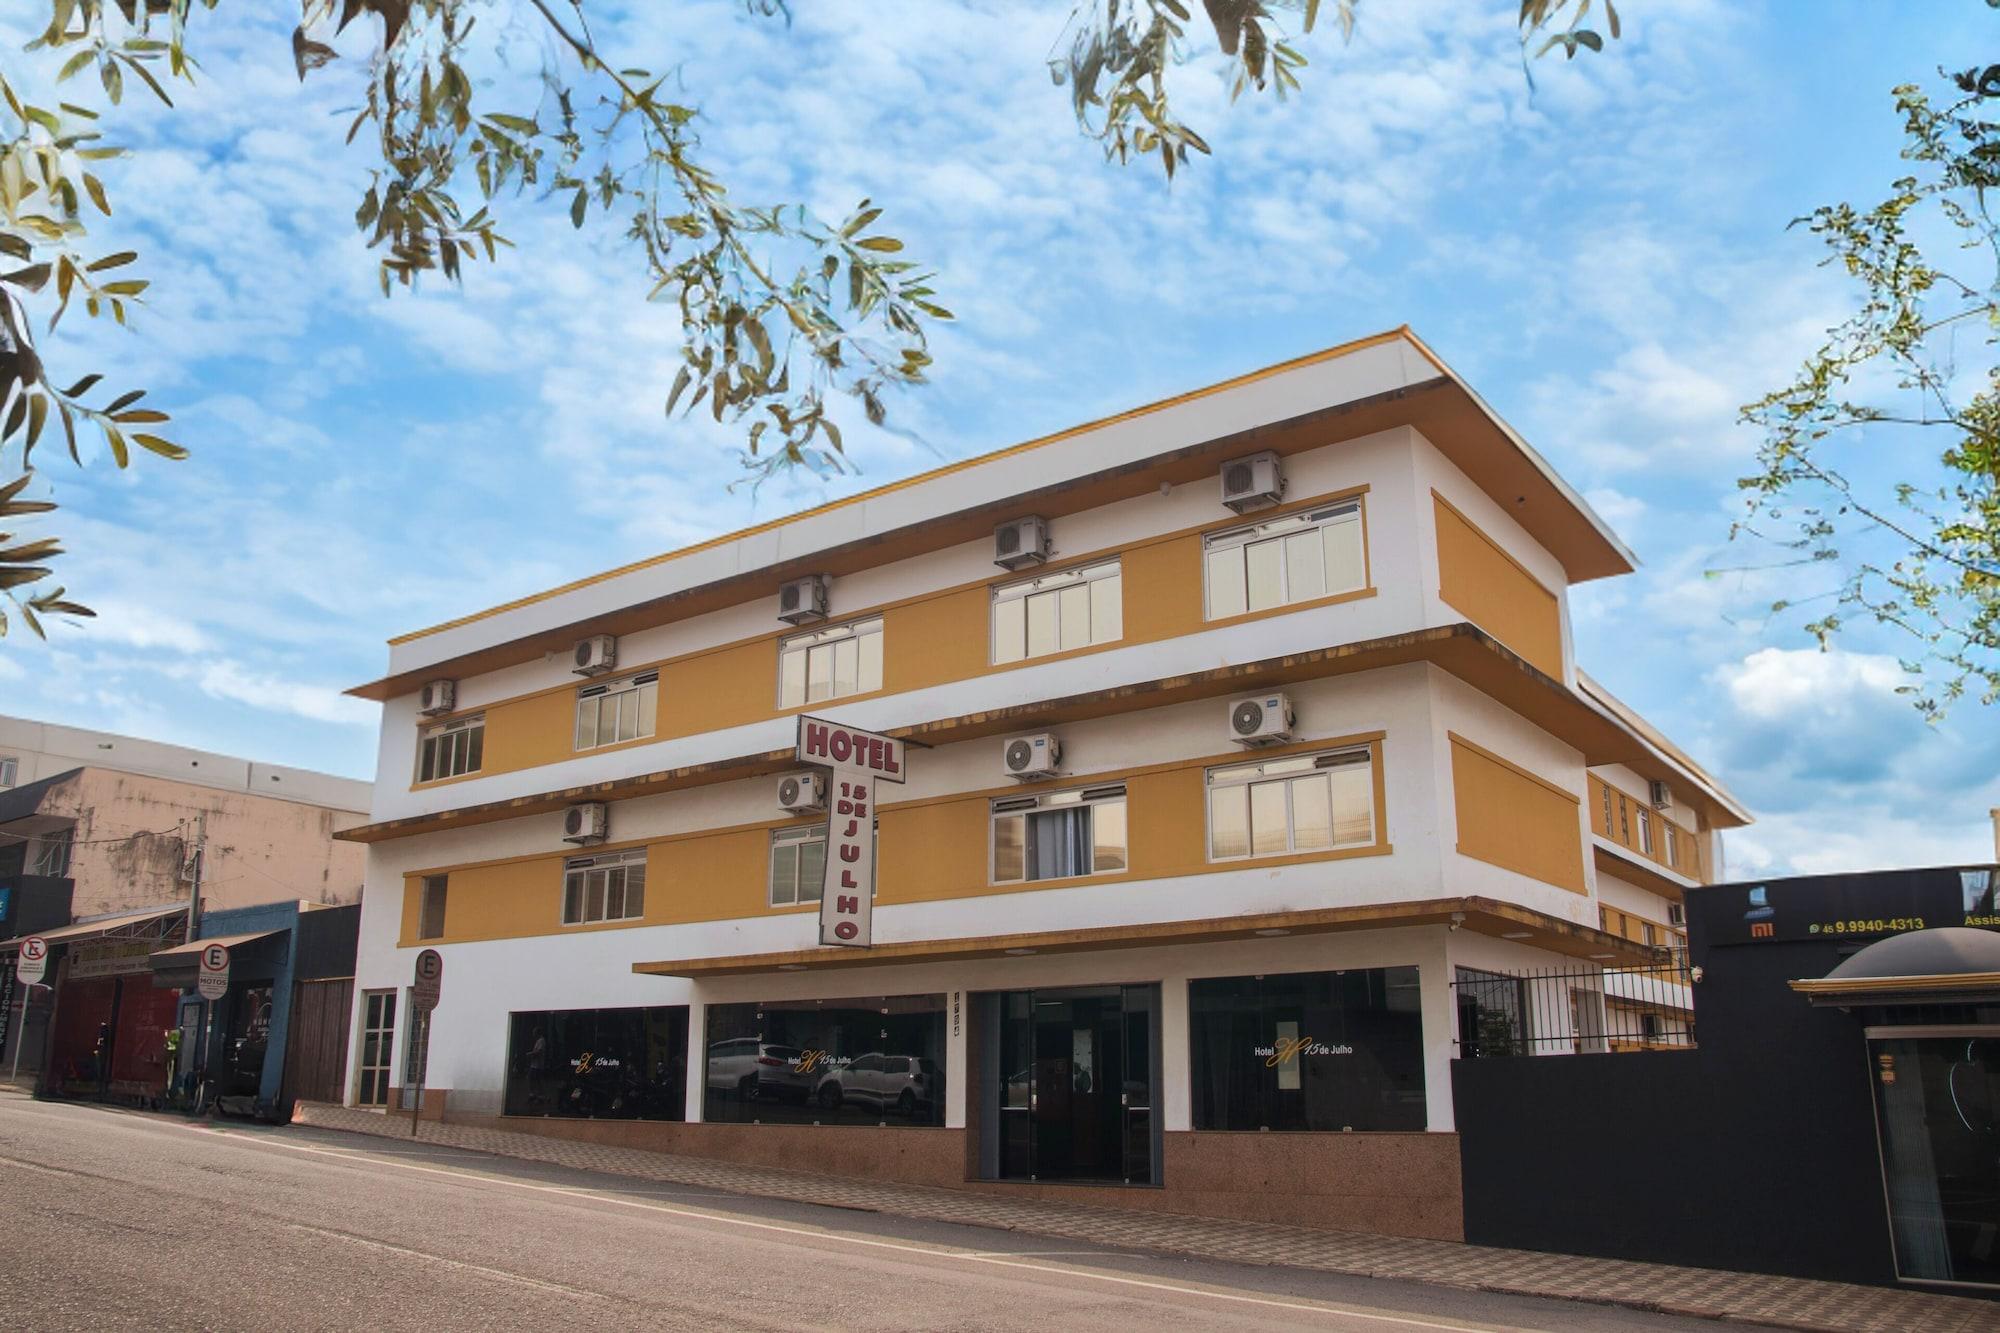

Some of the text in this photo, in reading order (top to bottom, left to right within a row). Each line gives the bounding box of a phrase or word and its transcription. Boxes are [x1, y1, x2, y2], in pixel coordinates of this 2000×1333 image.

[806, 722, 899, 774] HOTEL
[840, 782, 867, 801] 15
[837, 800, 867, 818] DE
[834, 819, 860, 941] JULHO
[1835, 917, 1925, 934] 9.9940-4313
[209, 949, 222, 966] E
[423, 955, 436, 974] E
[200, 977, 227, 987] MOTOS
[1254, 1046, 1274, 1057] Hotel
[1304, 1043, 1321, 1056] 15
[1320, 1046, 1329, 1055] de
[1330, 1045, 1353, 1055] Julho
